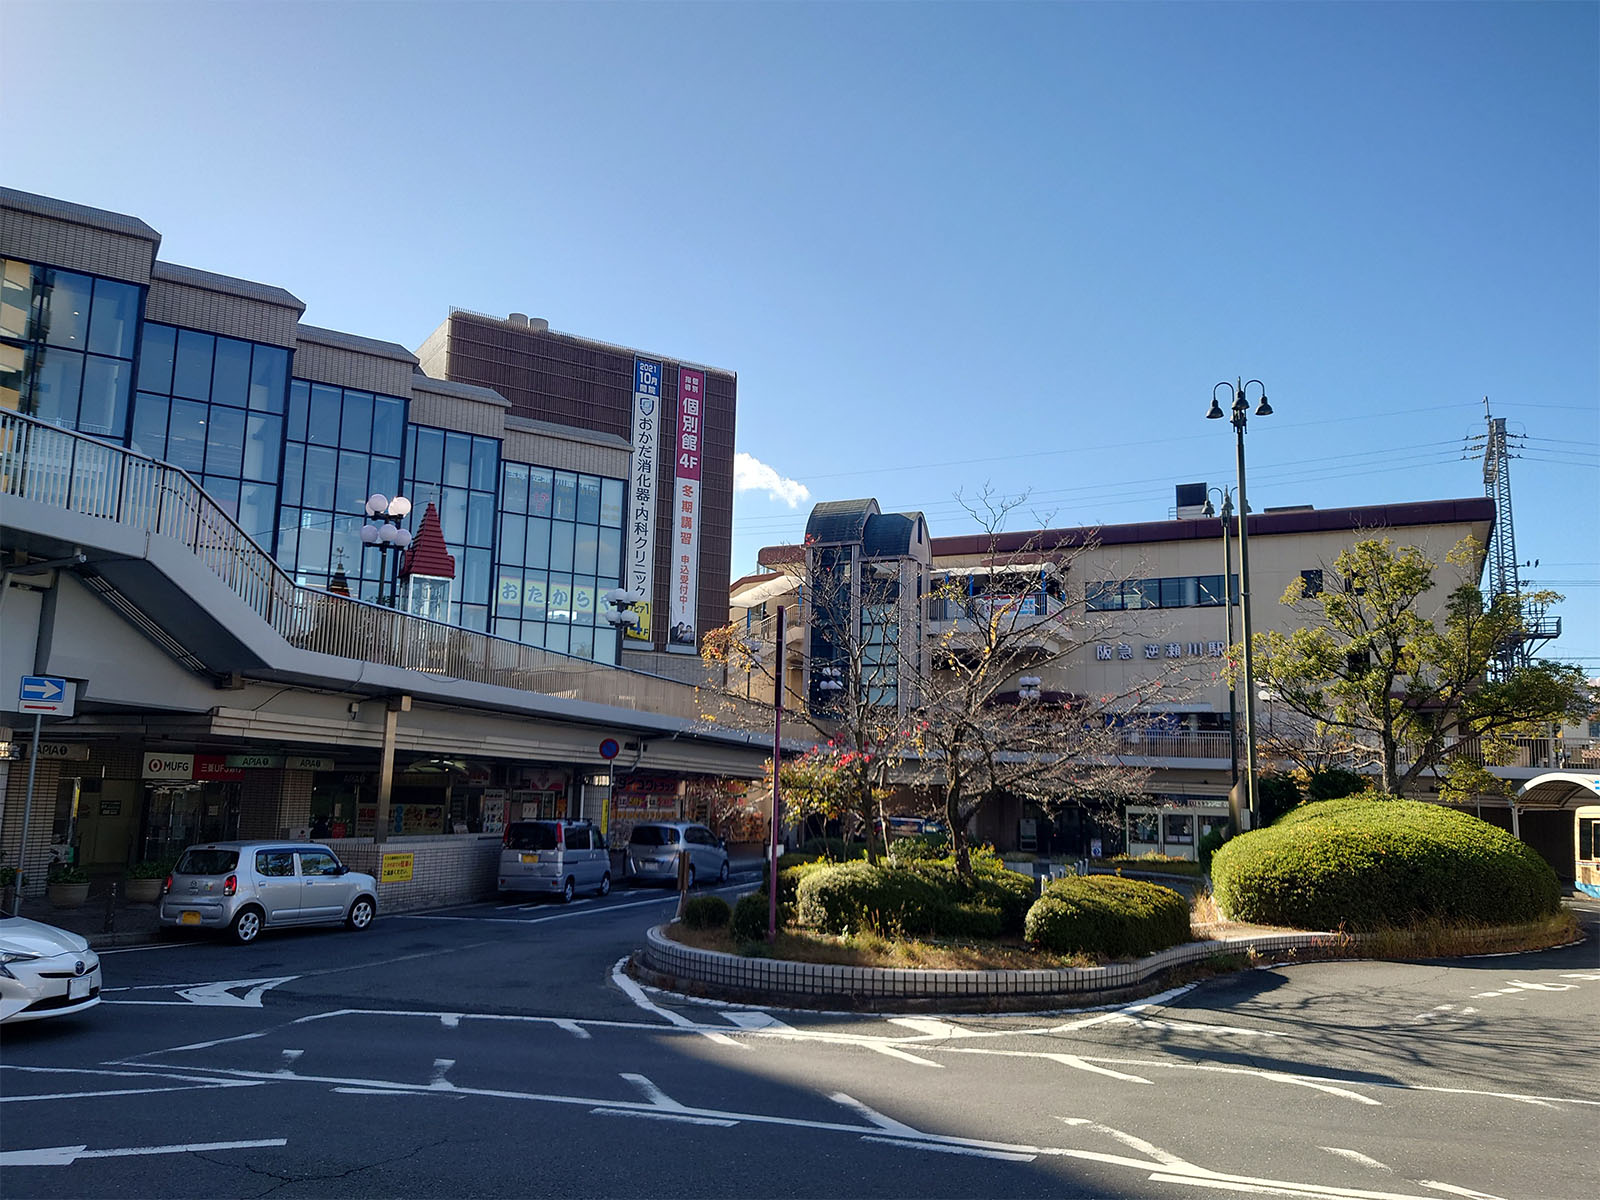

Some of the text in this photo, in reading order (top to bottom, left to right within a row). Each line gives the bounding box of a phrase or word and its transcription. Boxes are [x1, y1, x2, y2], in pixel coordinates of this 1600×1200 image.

[640, 362, 657, 373] 2021
[639, 372, 658, 386] 10月
[680, 397, 699, 469] 個別館 4F
[633, 417, 653, 596] おかだ消化器・内科クリニック
[680, 484, 694, 545] 冬期講習
[1096, 641, 1226, 660] 阪急 逆瀬川駅
[163, 762, 189, 771] MUFG
